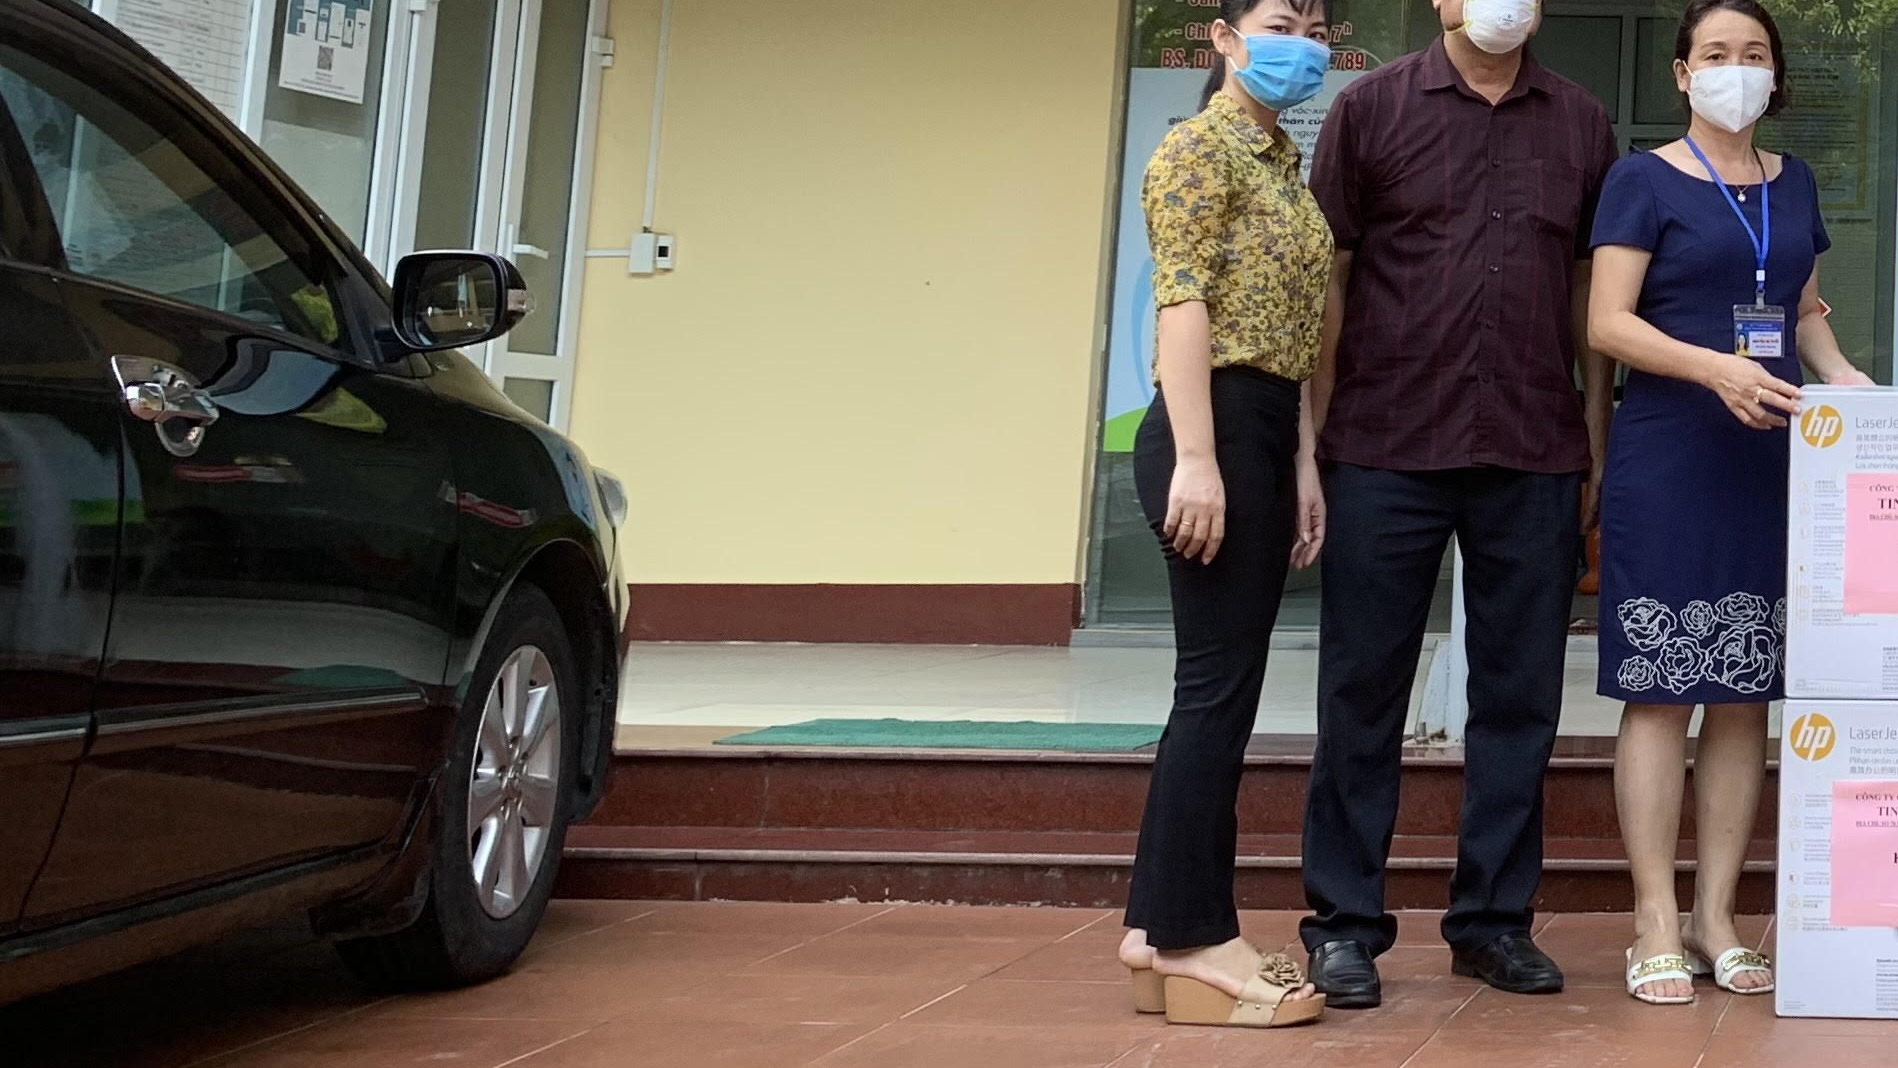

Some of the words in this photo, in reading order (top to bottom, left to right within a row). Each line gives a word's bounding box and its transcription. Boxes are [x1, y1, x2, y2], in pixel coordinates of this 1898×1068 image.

[1803, 405, 1842, 448] hp
[1792, 713, 1833, 762] hp
[1877, 806, 1898, 817] TIN
